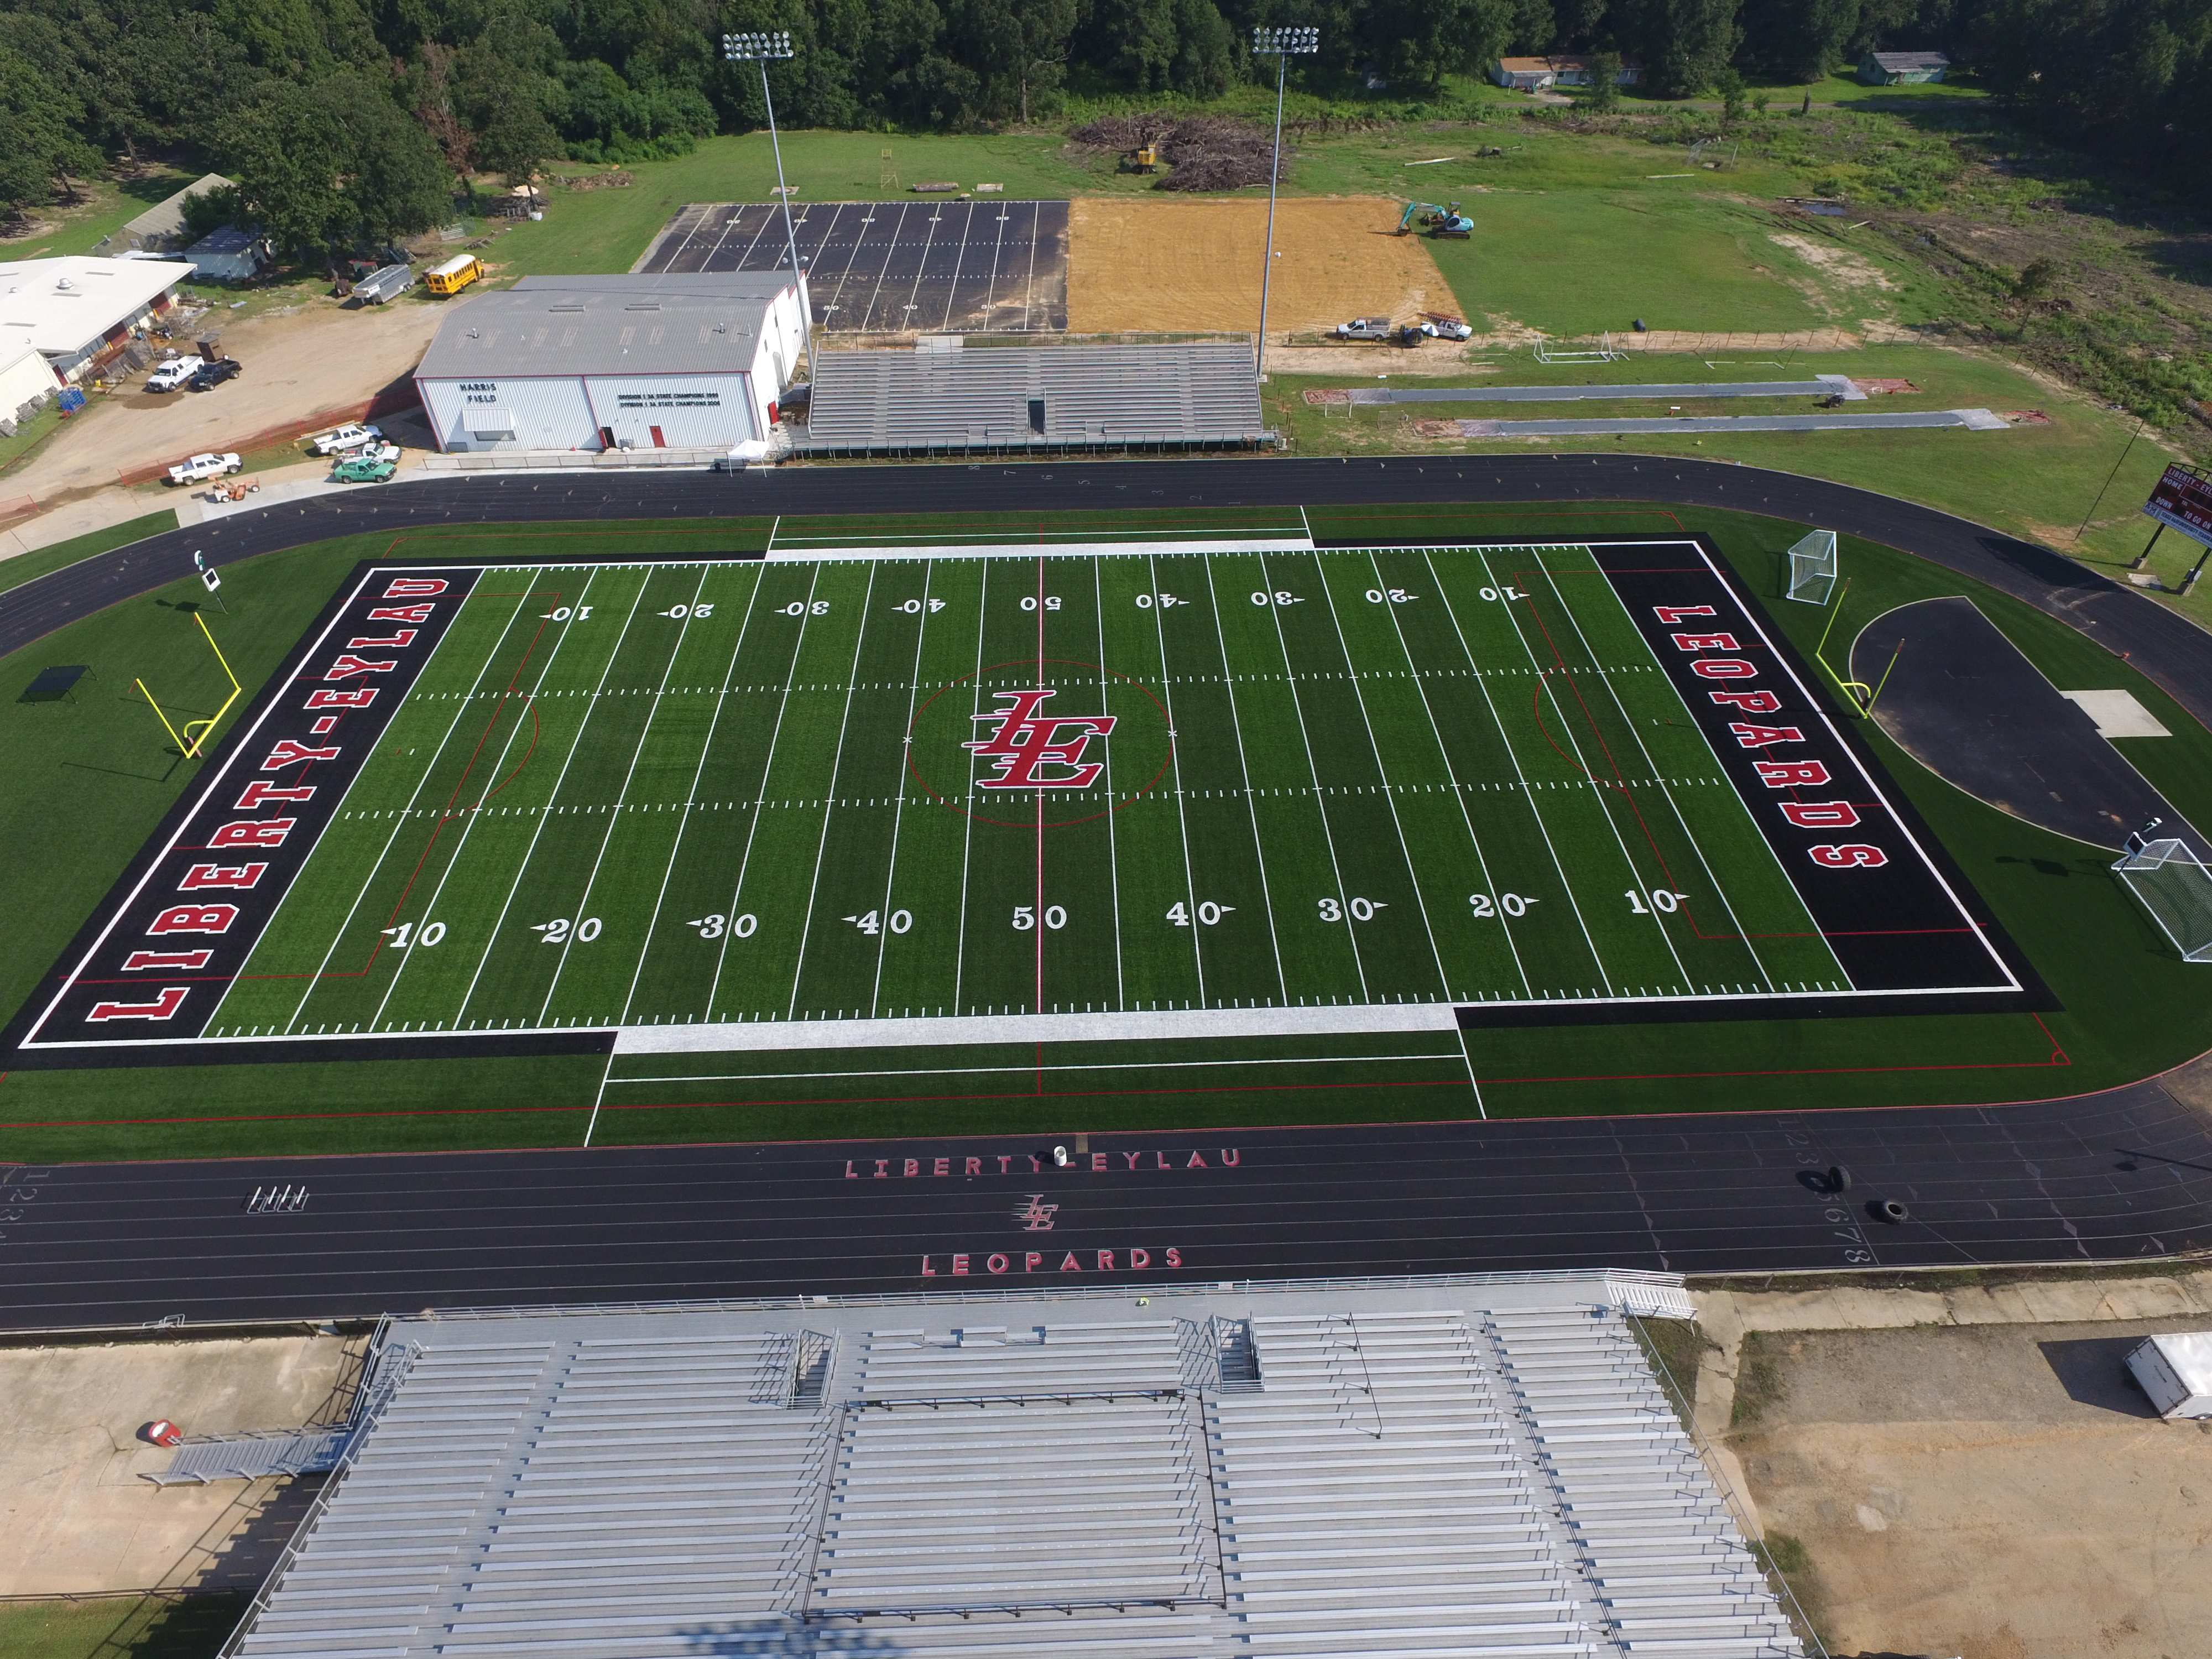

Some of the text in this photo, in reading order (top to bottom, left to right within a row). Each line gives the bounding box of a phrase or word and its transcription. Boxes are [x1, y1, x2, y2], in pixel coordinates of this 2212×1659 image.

[460, 383, 497, 391] HARRIS
[2162, 476, 2183, 490] HOME
[2168, 468, 2197, 485] LIBERTY
[2156, 497, 2173, 509] DOWN
[2184, 511, 2193, 519] TO
[552, 587, 1519, 621] 10 20 30 40 50 40 30 20 10
[1653, 605, 1889, 868] LEOPARDS
[85, 578, 449, 1022] LIBERTY-EYLAU
[389, 890, 1677, 948] 10 20 30 40 50 40 30 20 10
[1785, 1133, 1809, 1146] 2
[1796, 1152, 1819, 1164] 3
[23, 1170, 50, 1182] 1
[10, 1188, 38, 1202] 2
[1825, 1208, 1849, 1222] 6
[1834, 1227, 1862, 1243] 7
[921, 1247, 1183, 1276] LEOPARDS
[1845, 1249, 1871, 1263] 8
